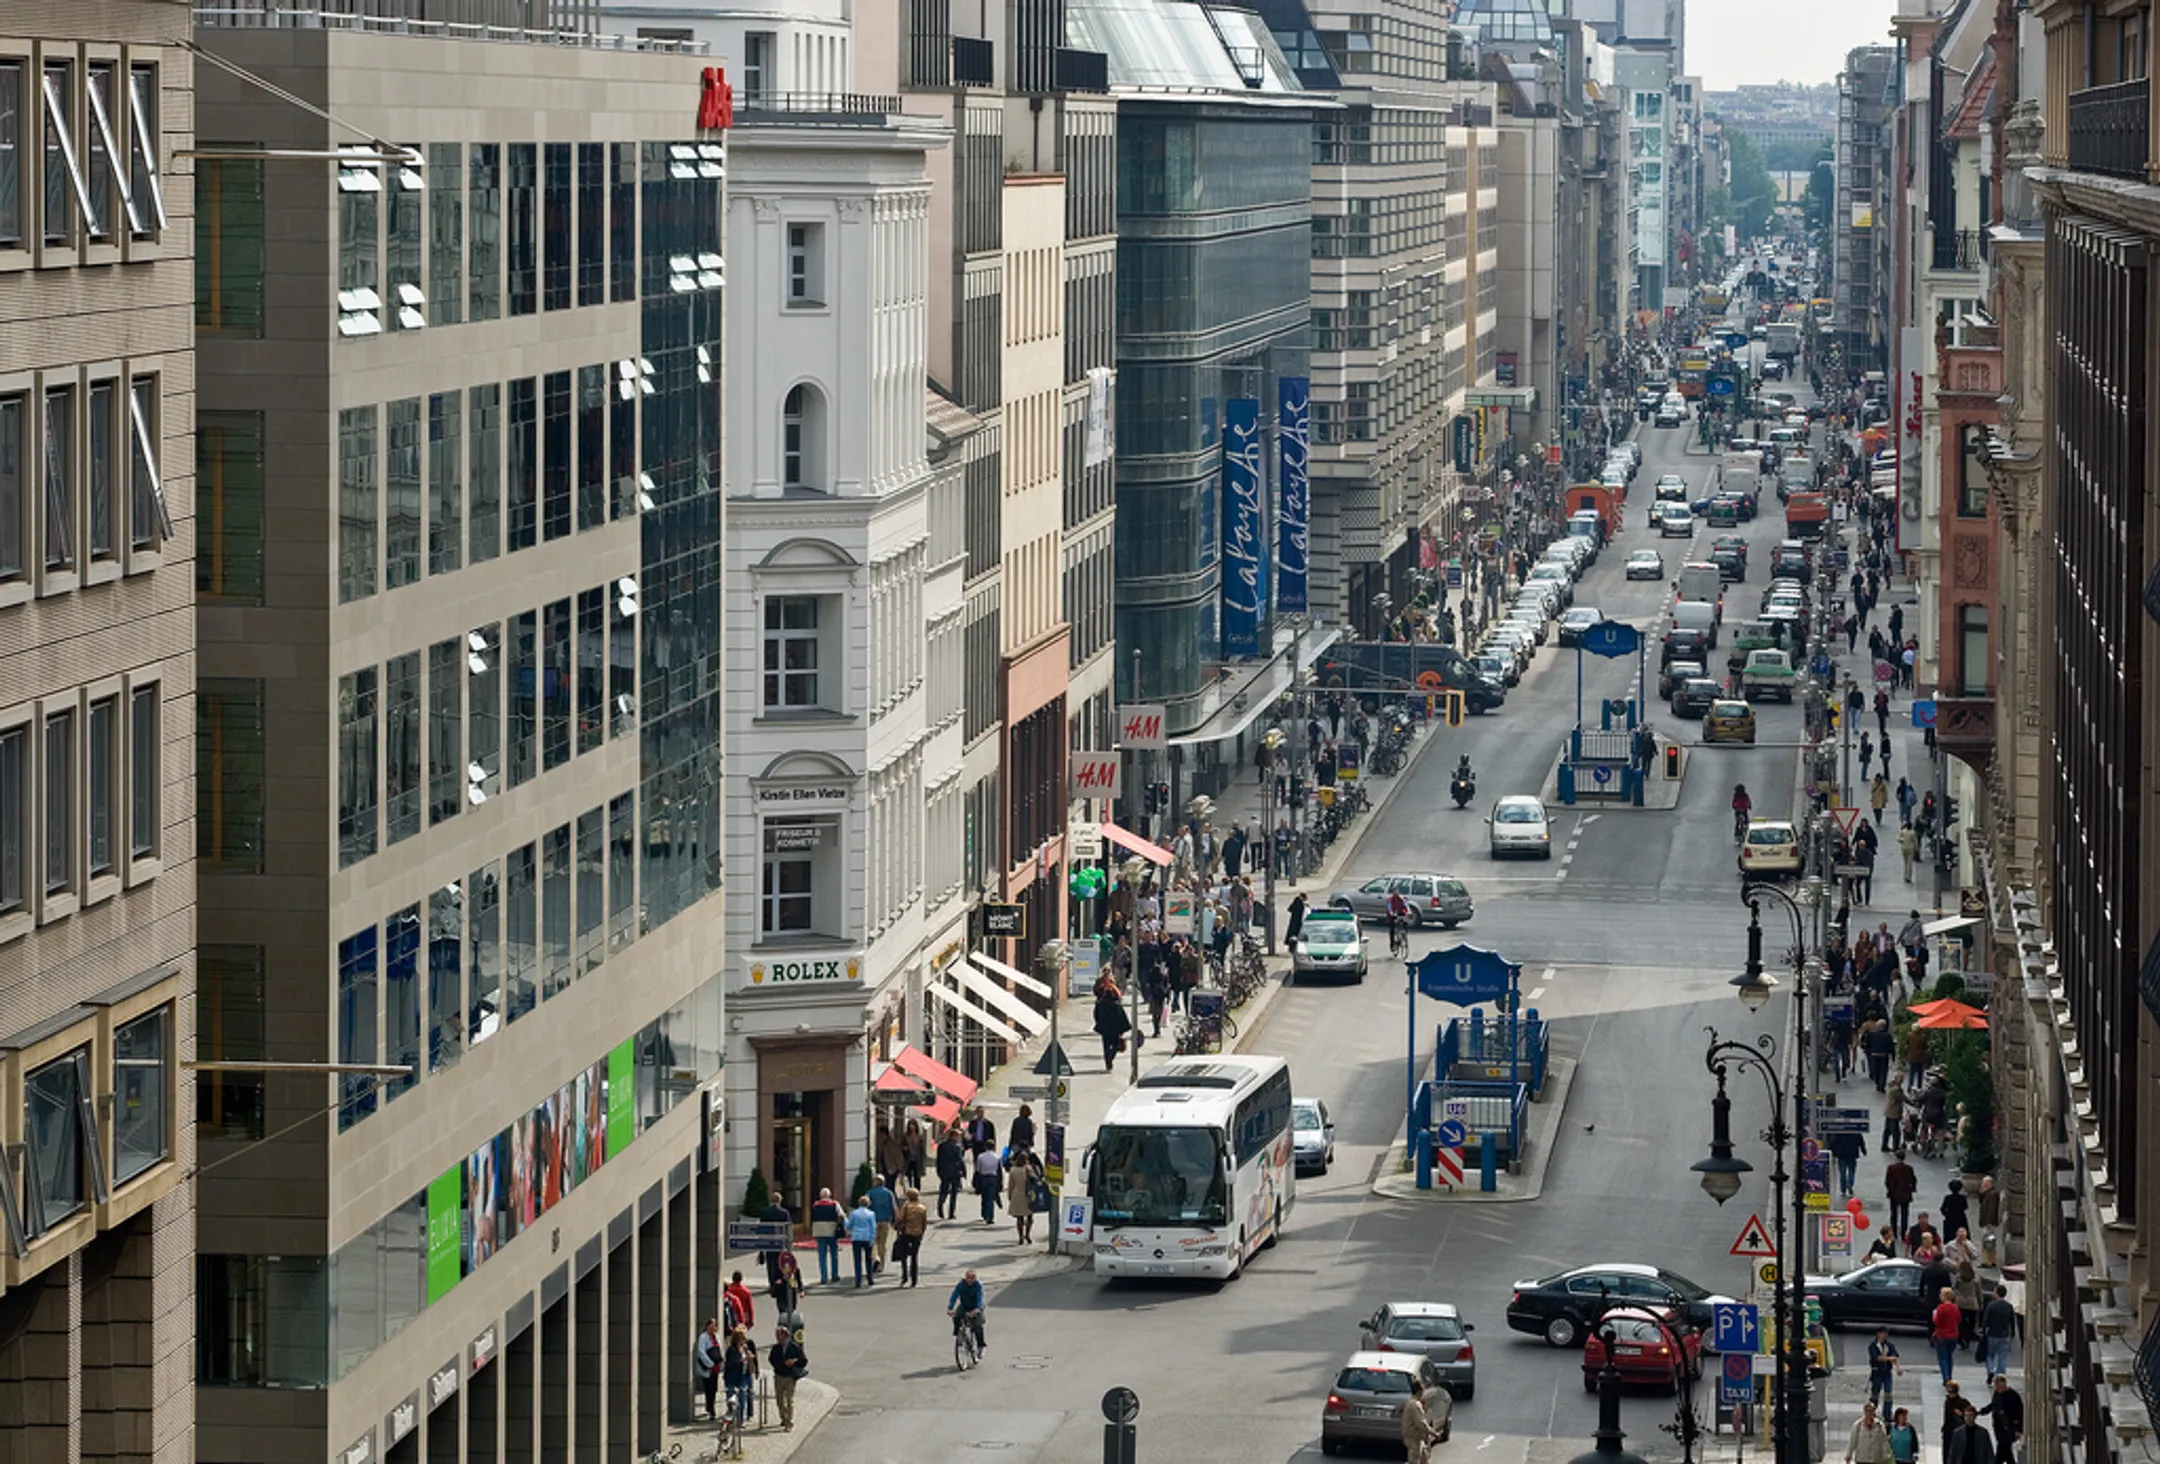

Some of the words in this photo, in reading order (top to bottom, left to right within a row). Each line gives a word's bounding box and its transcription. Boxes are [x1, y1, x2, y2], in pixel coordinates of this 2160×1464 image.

[1605, 629, 1617, 644] U
[1124, 715, 1161, 740] H&M
[1076, 761, 1117, 789] H&M
[760, 789, 790, 800] Kirstin
[793, 789, 815, 799] Ellen
[988, 921, 1013, 929] BLANC
[772, 961, 839, 981] ROLEX
[1455, 963, 1471, 982] U
[1719, 1316, 1733, 1340] P
[1726, 1387, 1750, 1398] TAXI
